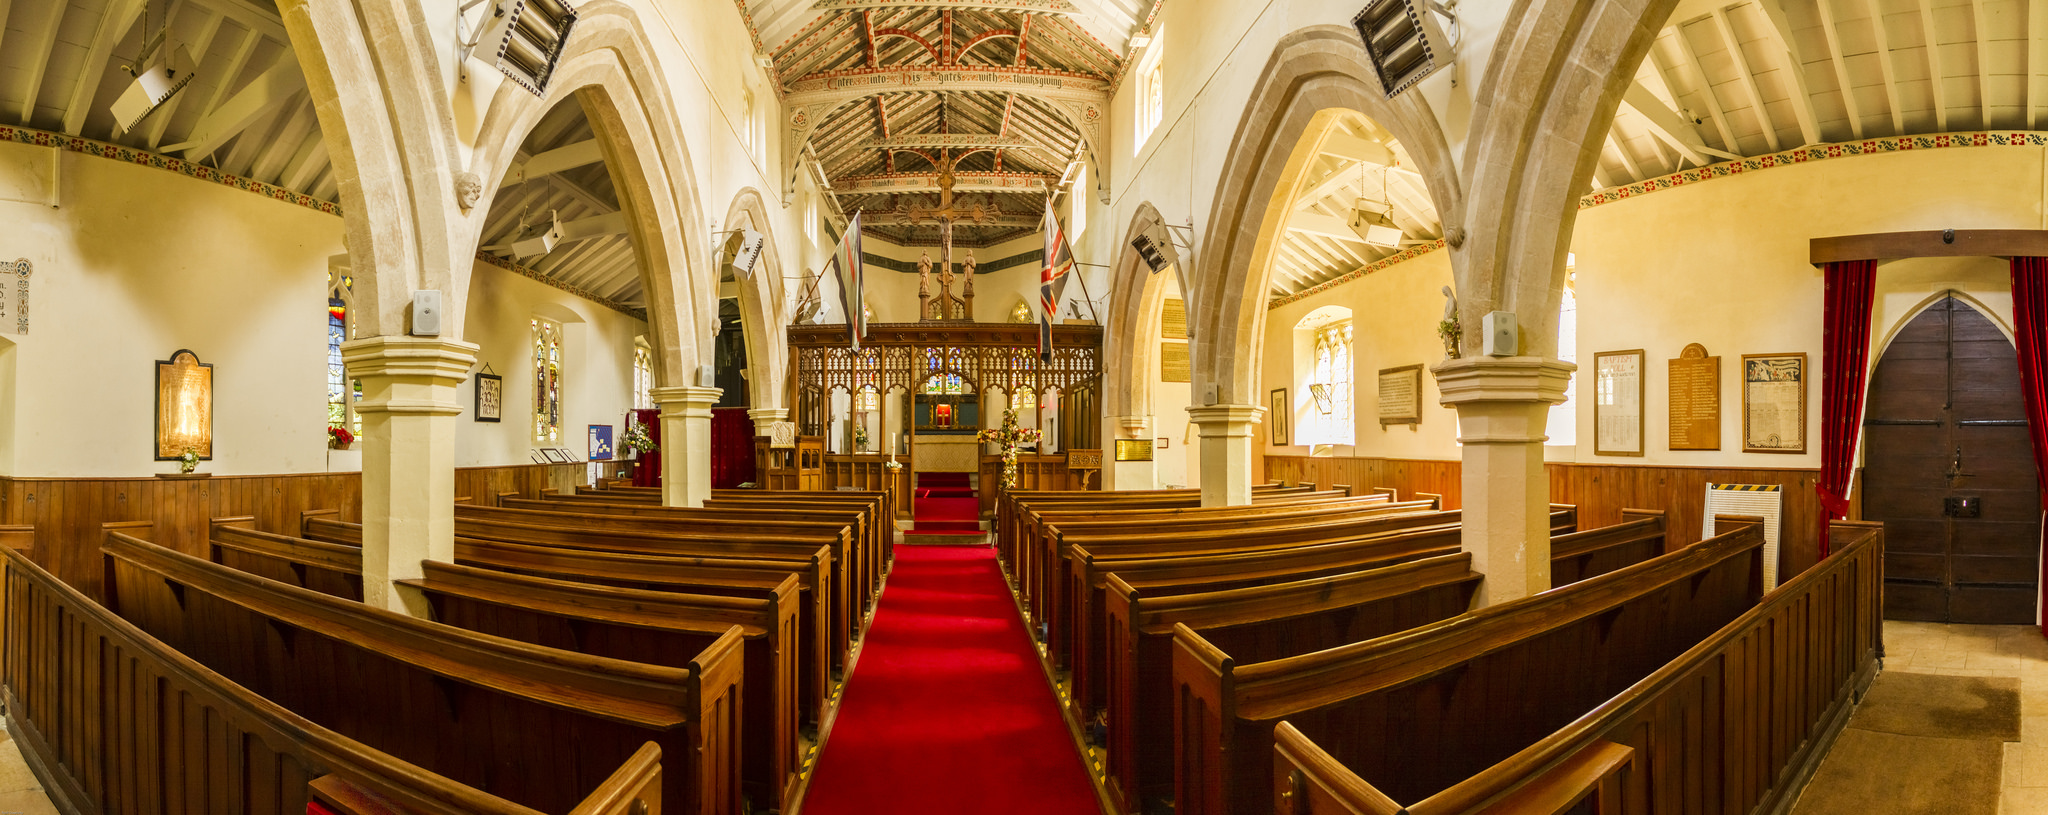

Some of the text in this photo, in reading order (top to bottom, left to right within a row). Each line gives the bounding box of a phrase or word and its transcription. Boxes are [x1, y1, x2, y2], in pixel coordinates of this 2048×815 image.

[870, 75, 886, 84] into
[938, 72, 961, 84] gates
[979, 72, 998, 84] with
